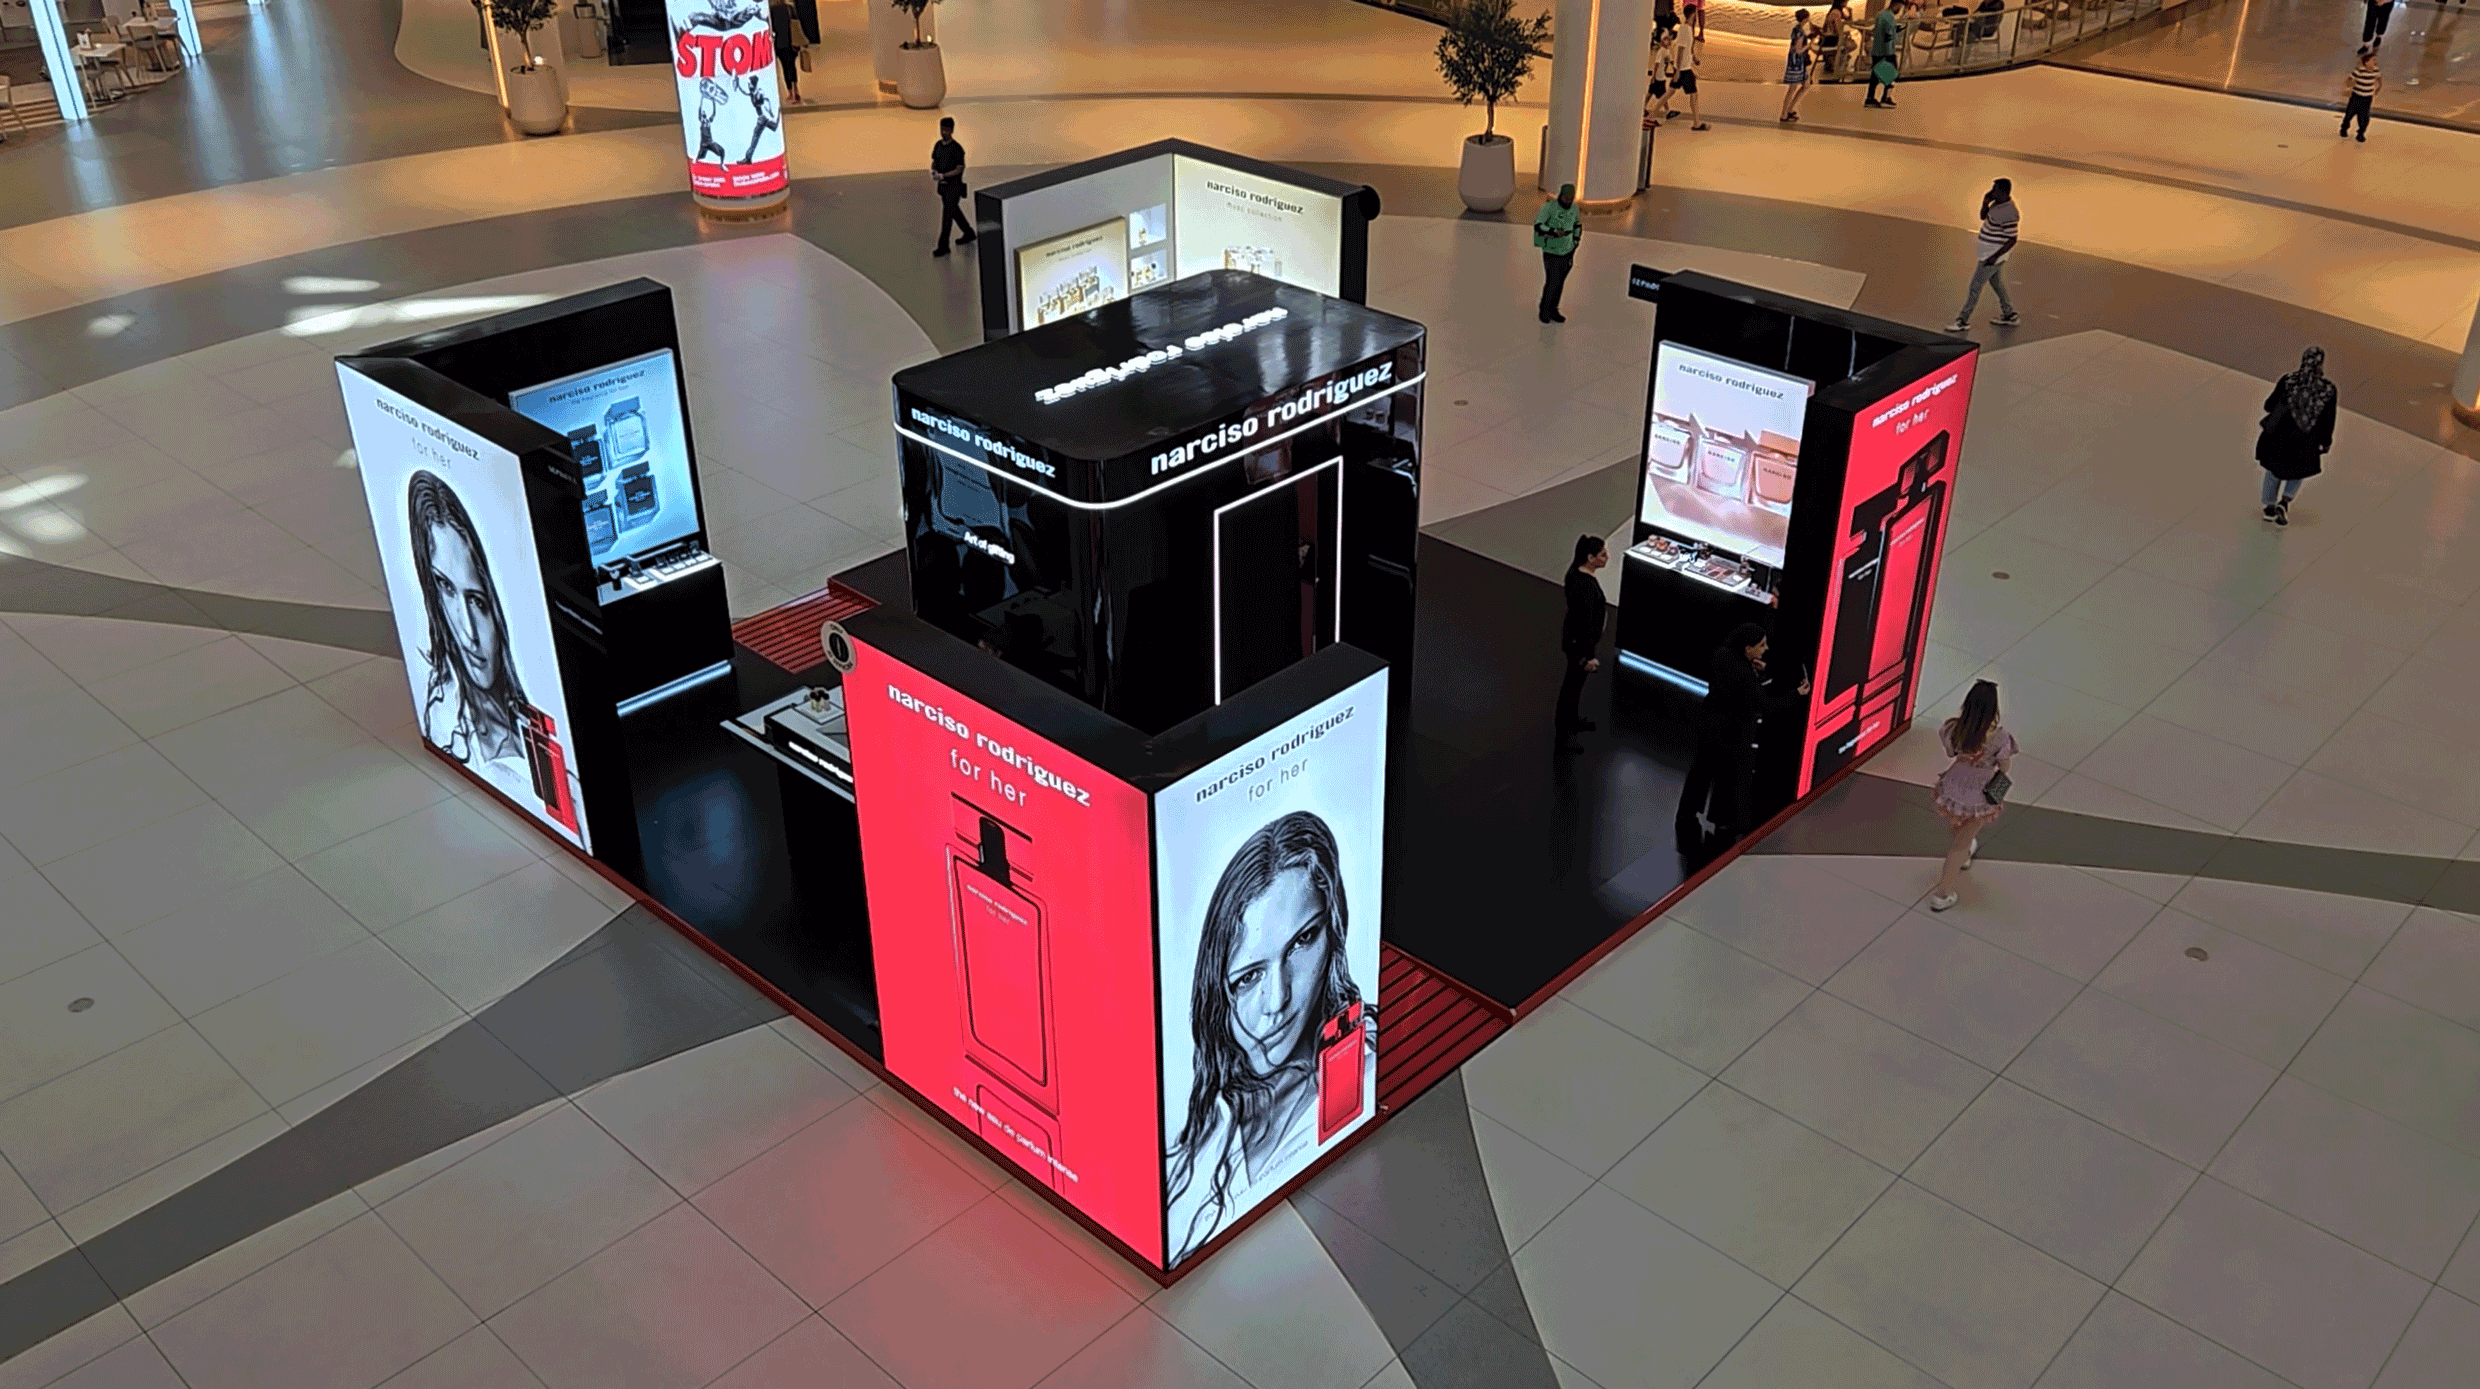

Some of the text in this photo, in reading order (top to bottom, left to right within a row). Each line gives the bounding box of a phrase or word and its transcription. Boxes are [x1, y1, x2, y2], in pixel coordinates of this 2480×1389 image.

[1207, 180, 1304, 215] narciso rodriguez
[1679, 364, 1784, 399] narciso rodriguez
[1872, 373, 1957, 428] narciso rodriguez
[376, 399, 481, 461] narciso rodriguez
[911, 407, 971, 442] narciso
[974, 433, 1056, 478] rodriguez
[1151, 361, 1393, 475] narciso rodriguez
[888, 684, 1090, 807] narciso rodriguez
[1196, 705, 1355, 803] narciso rodriguez
[950, 748, 1026, 808] for her
[1248, 758, 1308, 802] for her
